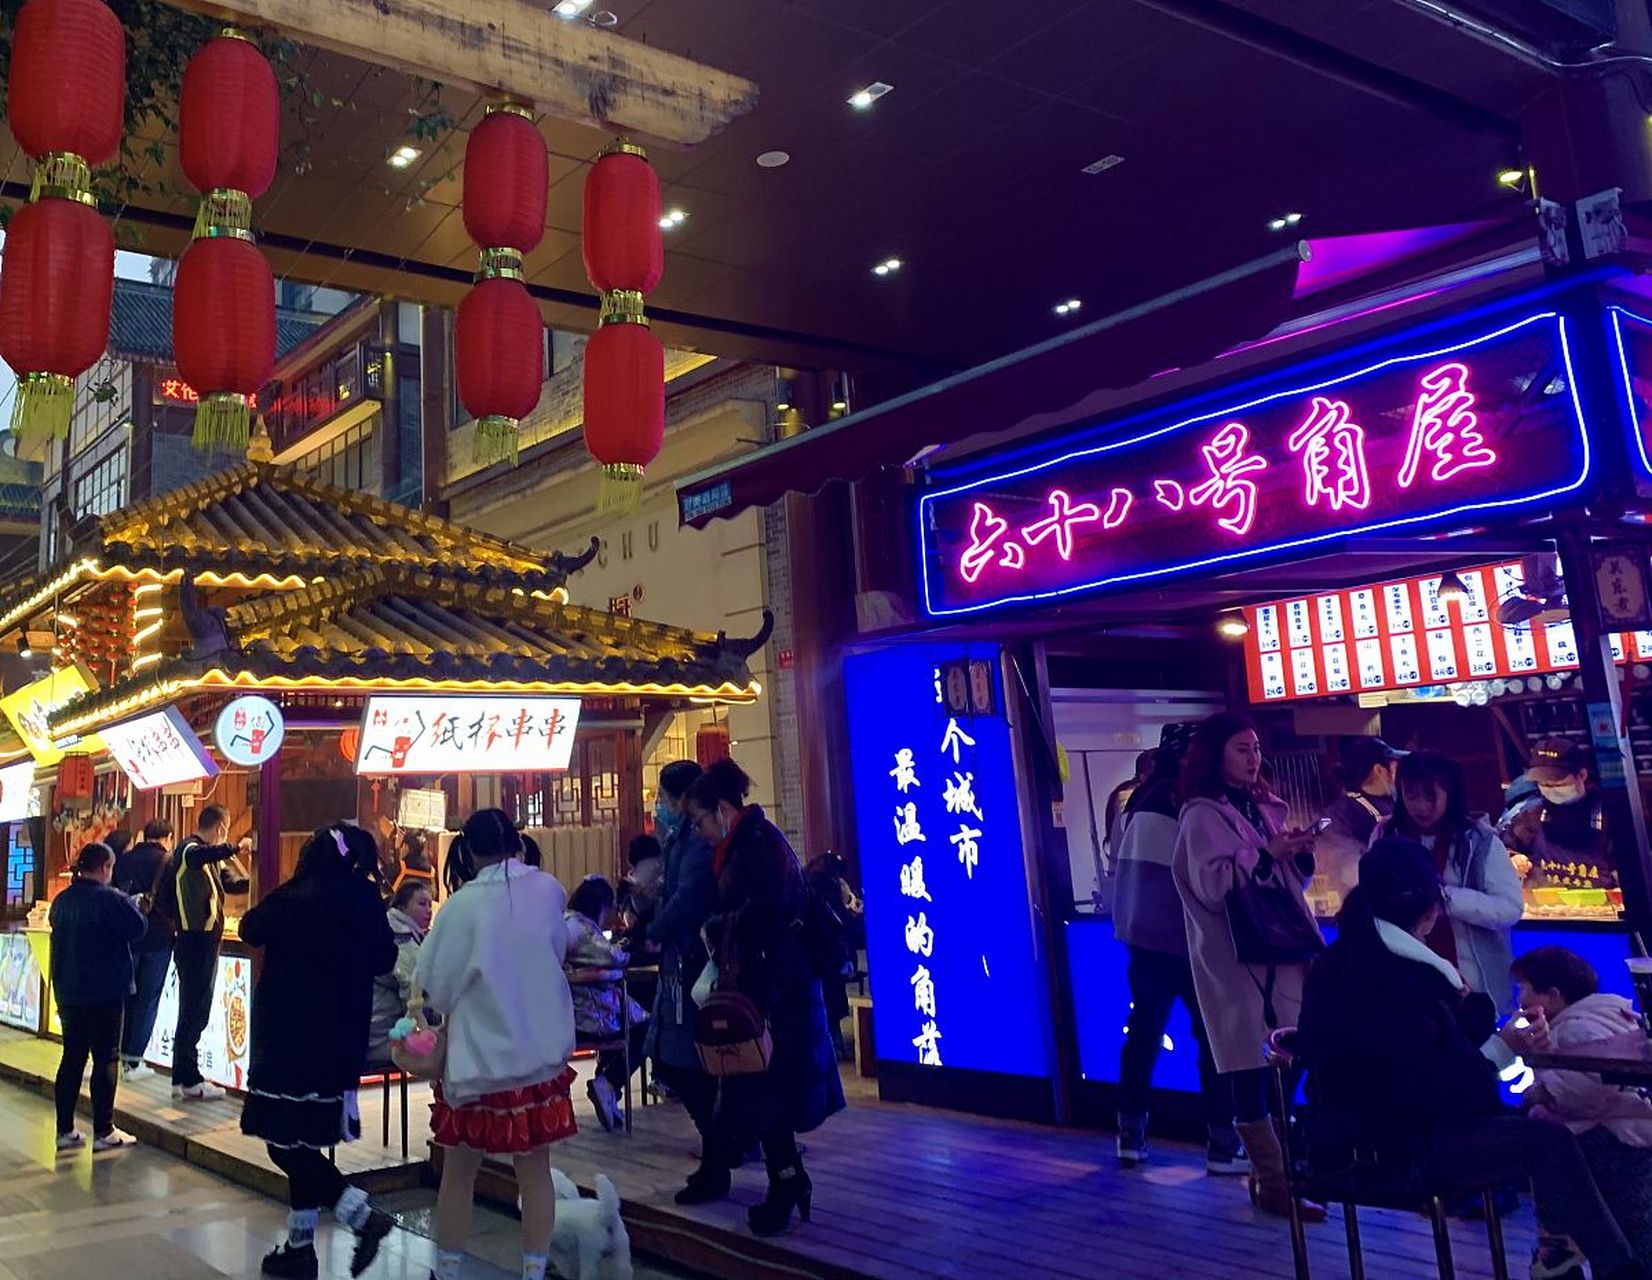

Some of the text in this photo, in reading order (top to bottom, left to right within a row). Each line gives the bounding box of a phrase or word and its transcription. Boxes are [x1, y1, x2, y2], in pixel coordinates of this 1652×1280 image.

[959, 362, 1497, 582] 六十八号角屋
[889, 748, 943, 1066] 最温暖的角落
